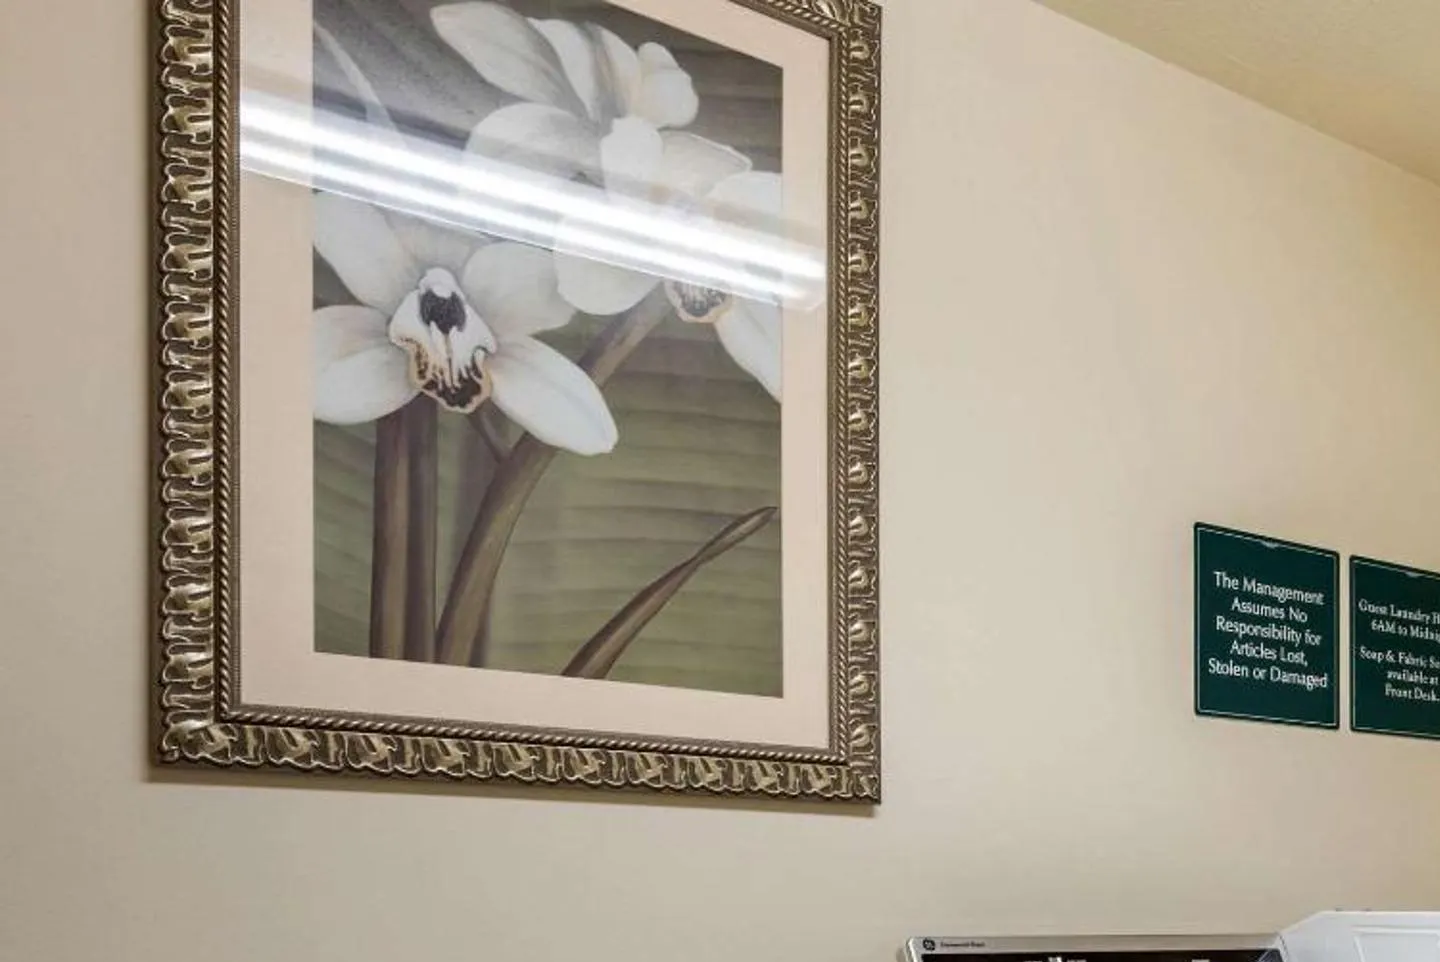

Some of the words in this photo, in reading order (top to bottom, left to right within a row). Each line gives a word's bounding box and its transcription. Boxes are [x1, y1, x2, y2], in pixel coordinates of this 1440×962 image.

[1213, 571, 1239, 590] The
[1242, 577, 1324, 604] Management
[1231, 597, 1285, 619] Assumes
[1289, 606, 1308, 623] No
[1358, 598, 1388, 615] Guest
[1390, 604, 1430, 624] Laundry
[1216, 616, 1302, 646] Responsibility
[1304, 629, 1322, 646] for
[1371, 619, 1396, 634] 6AM
[1398, 625, 1407, 636] to
[1230, 640, 1277, 660] Articles
[1280, 648, 1308, 666] Lost,
[1360, 646, 1384, 663] Soap
[1386, 650, 1396, 663] &
[1398, 652, 1427, 668] Fabric
[1208, 659, 1249, 678] Stolen
[1252, 667, 1267, 680] or
[1270, 666, 1328, 690] Damaged
[1387, 670, 1428, 684] available
[1429, 677, 1438, 685] at
[1385, 683, 1412, 700] Front
